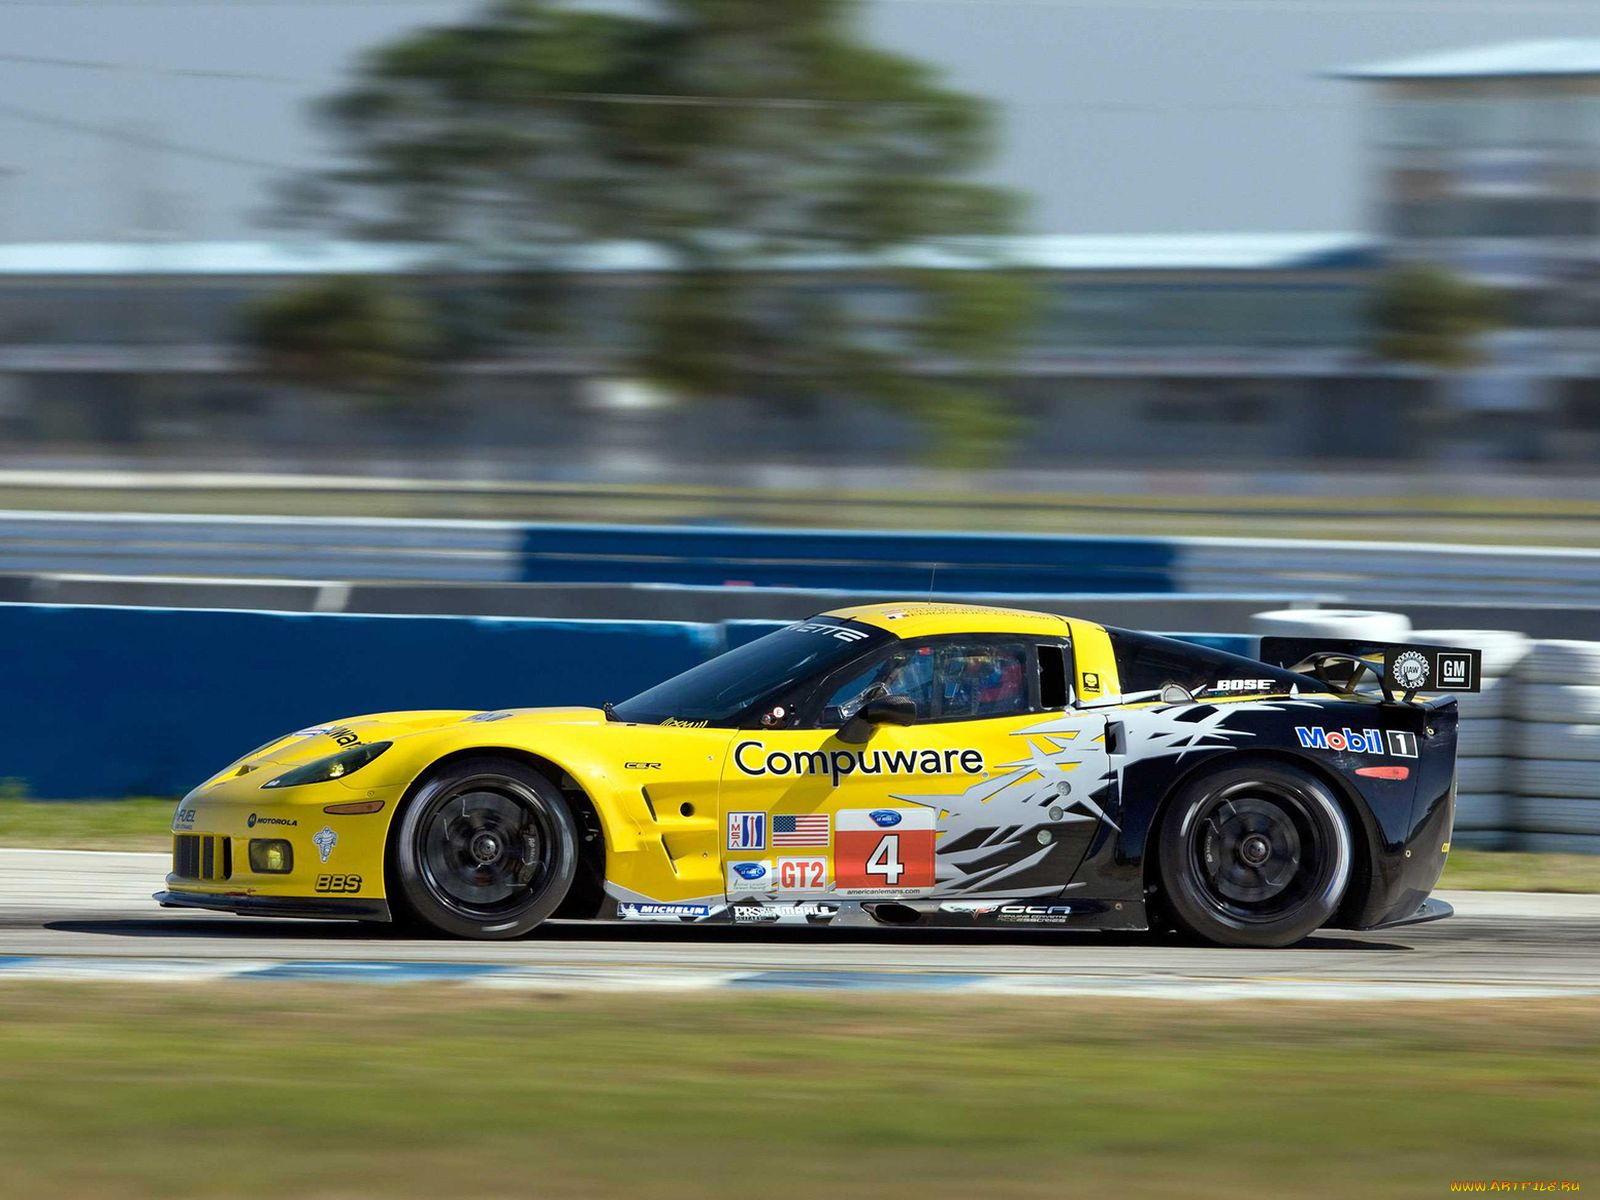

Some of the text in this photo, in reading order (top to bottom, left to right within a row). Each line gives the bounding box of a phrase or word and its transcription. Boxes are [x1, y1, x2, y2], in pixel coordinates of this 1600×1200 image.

[1403, 665, 1420, 674] UAW
[1443, 660, 1465, 677] GM
[1216, 679, 1276, 691] BOSE
[1295, 726, 1384, 755] Mobil
[735, 741, 983, 787] Compuware
[257, 817, 298, 827] MOTOROLA
[730, 815, 741, 848] IMSA
[865, 833, 905, 886] 4
[315, 874, 363, 893] BBS
[781, 861, 824, 889] GT2
[846, 888, 921, 896] americanlemans.com
[640, 905, 706, 915] MICHELIN
